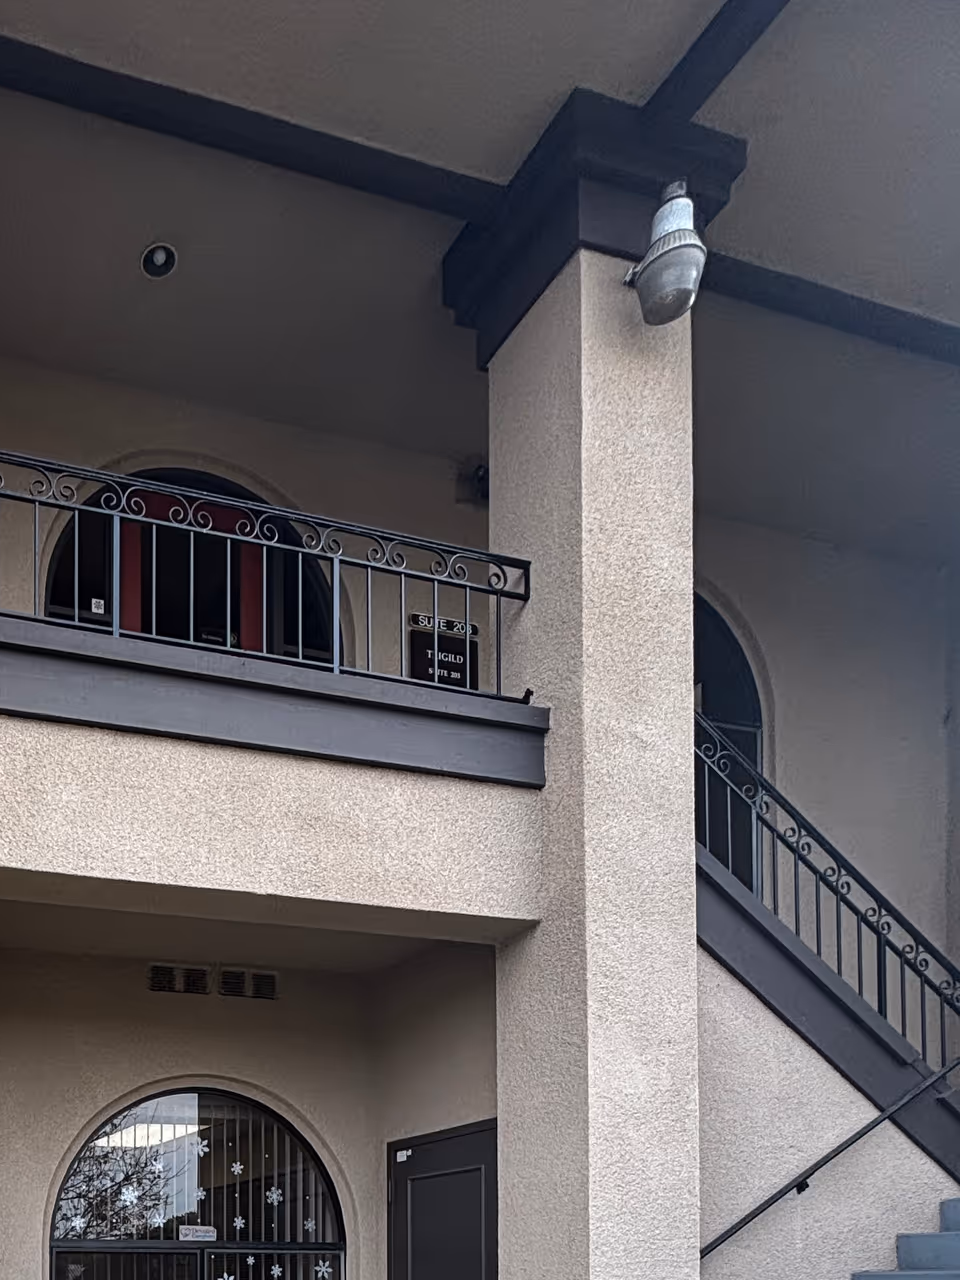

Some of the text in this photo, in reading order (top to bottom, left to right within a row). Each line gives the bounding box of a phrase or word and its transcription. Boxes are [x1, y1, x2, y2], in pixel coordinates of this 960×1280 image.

[418, 616, 448, 630] SUTE
[426, 649, 464, 664] TIGILD
[428, 667, 449, 677] SITE
